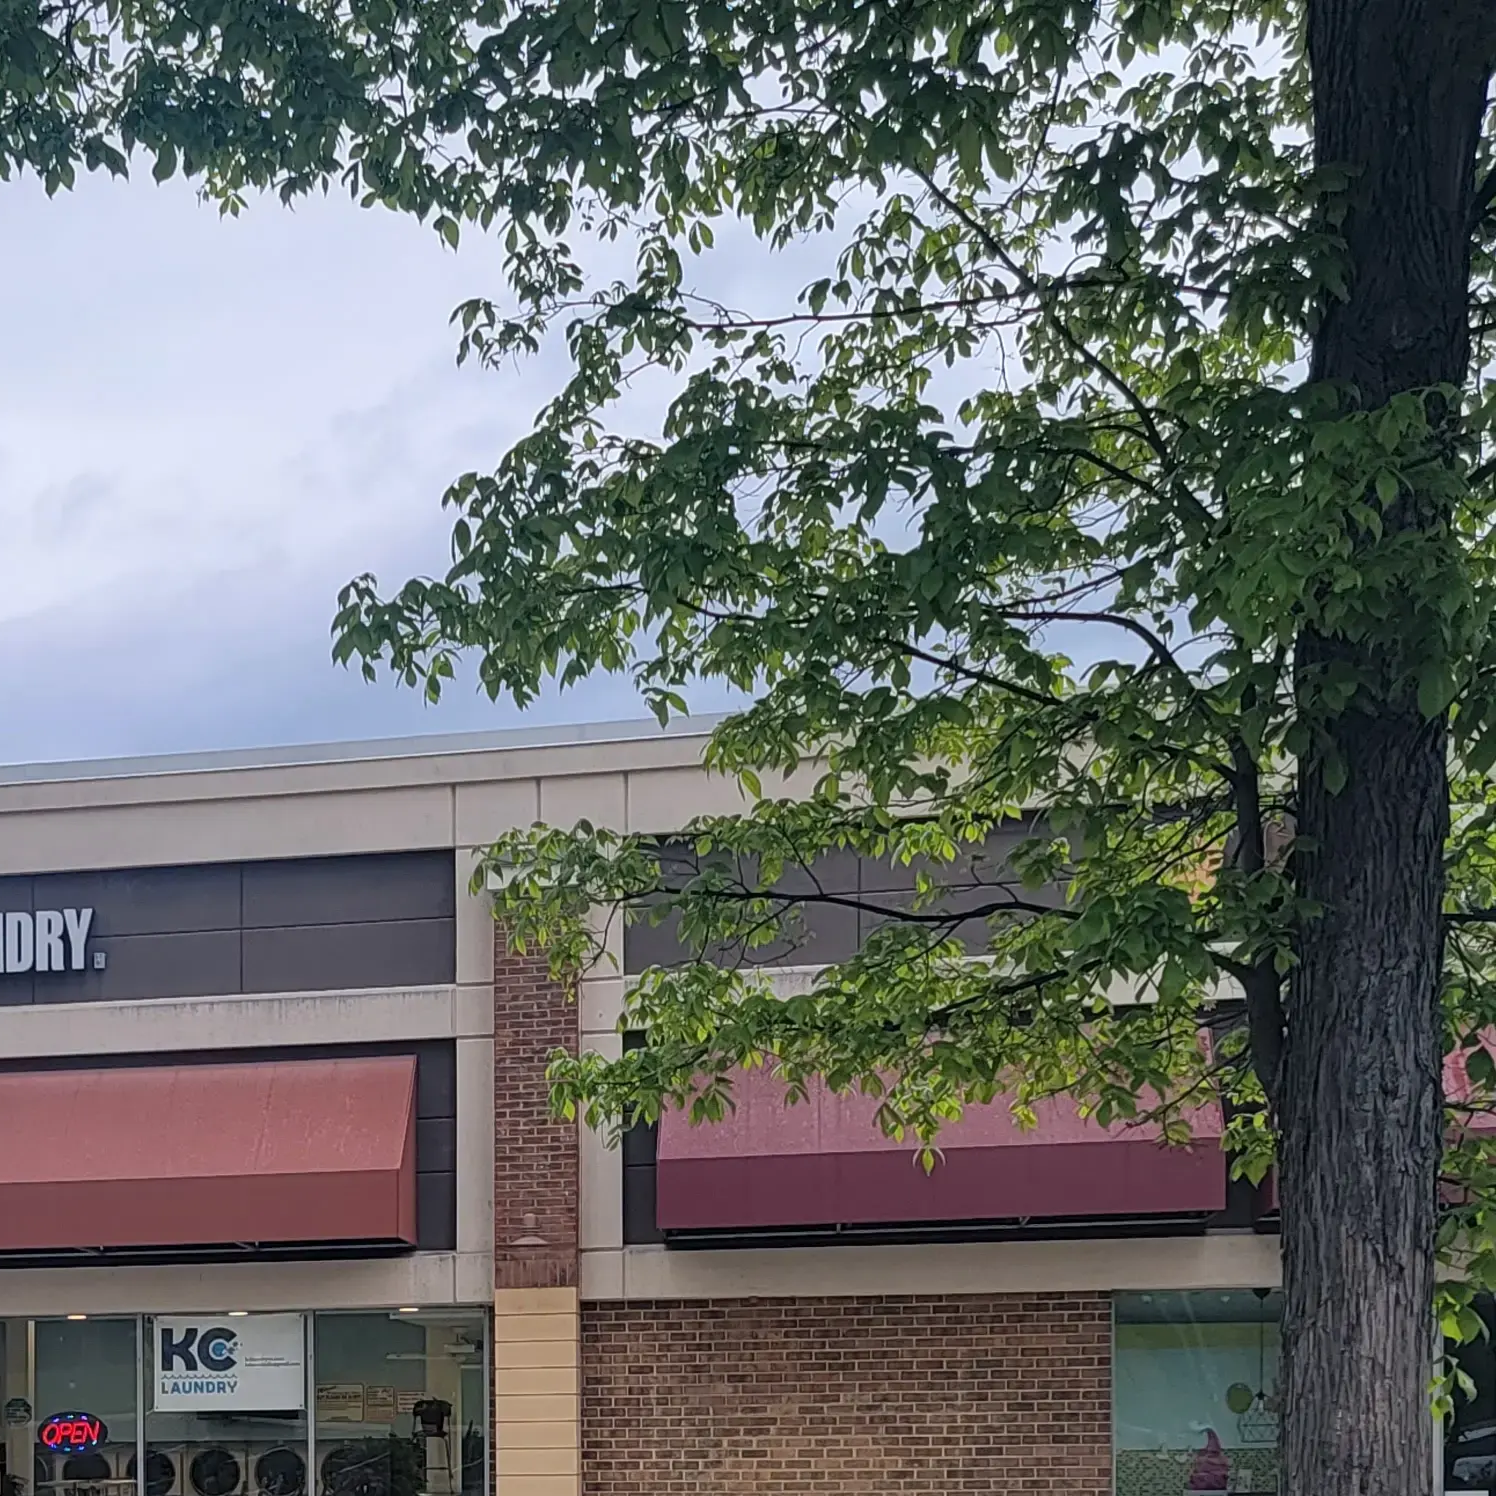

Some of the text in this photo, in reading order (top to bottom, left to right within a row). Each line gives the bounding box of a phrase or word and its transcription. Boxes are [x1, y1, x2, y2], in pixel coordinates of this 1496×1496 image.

[161, 1327, 238, 1372] KC
[161, 1381, 238, 1395] LAUNDRY
[42, 1420, 100, 1446] OPEN
